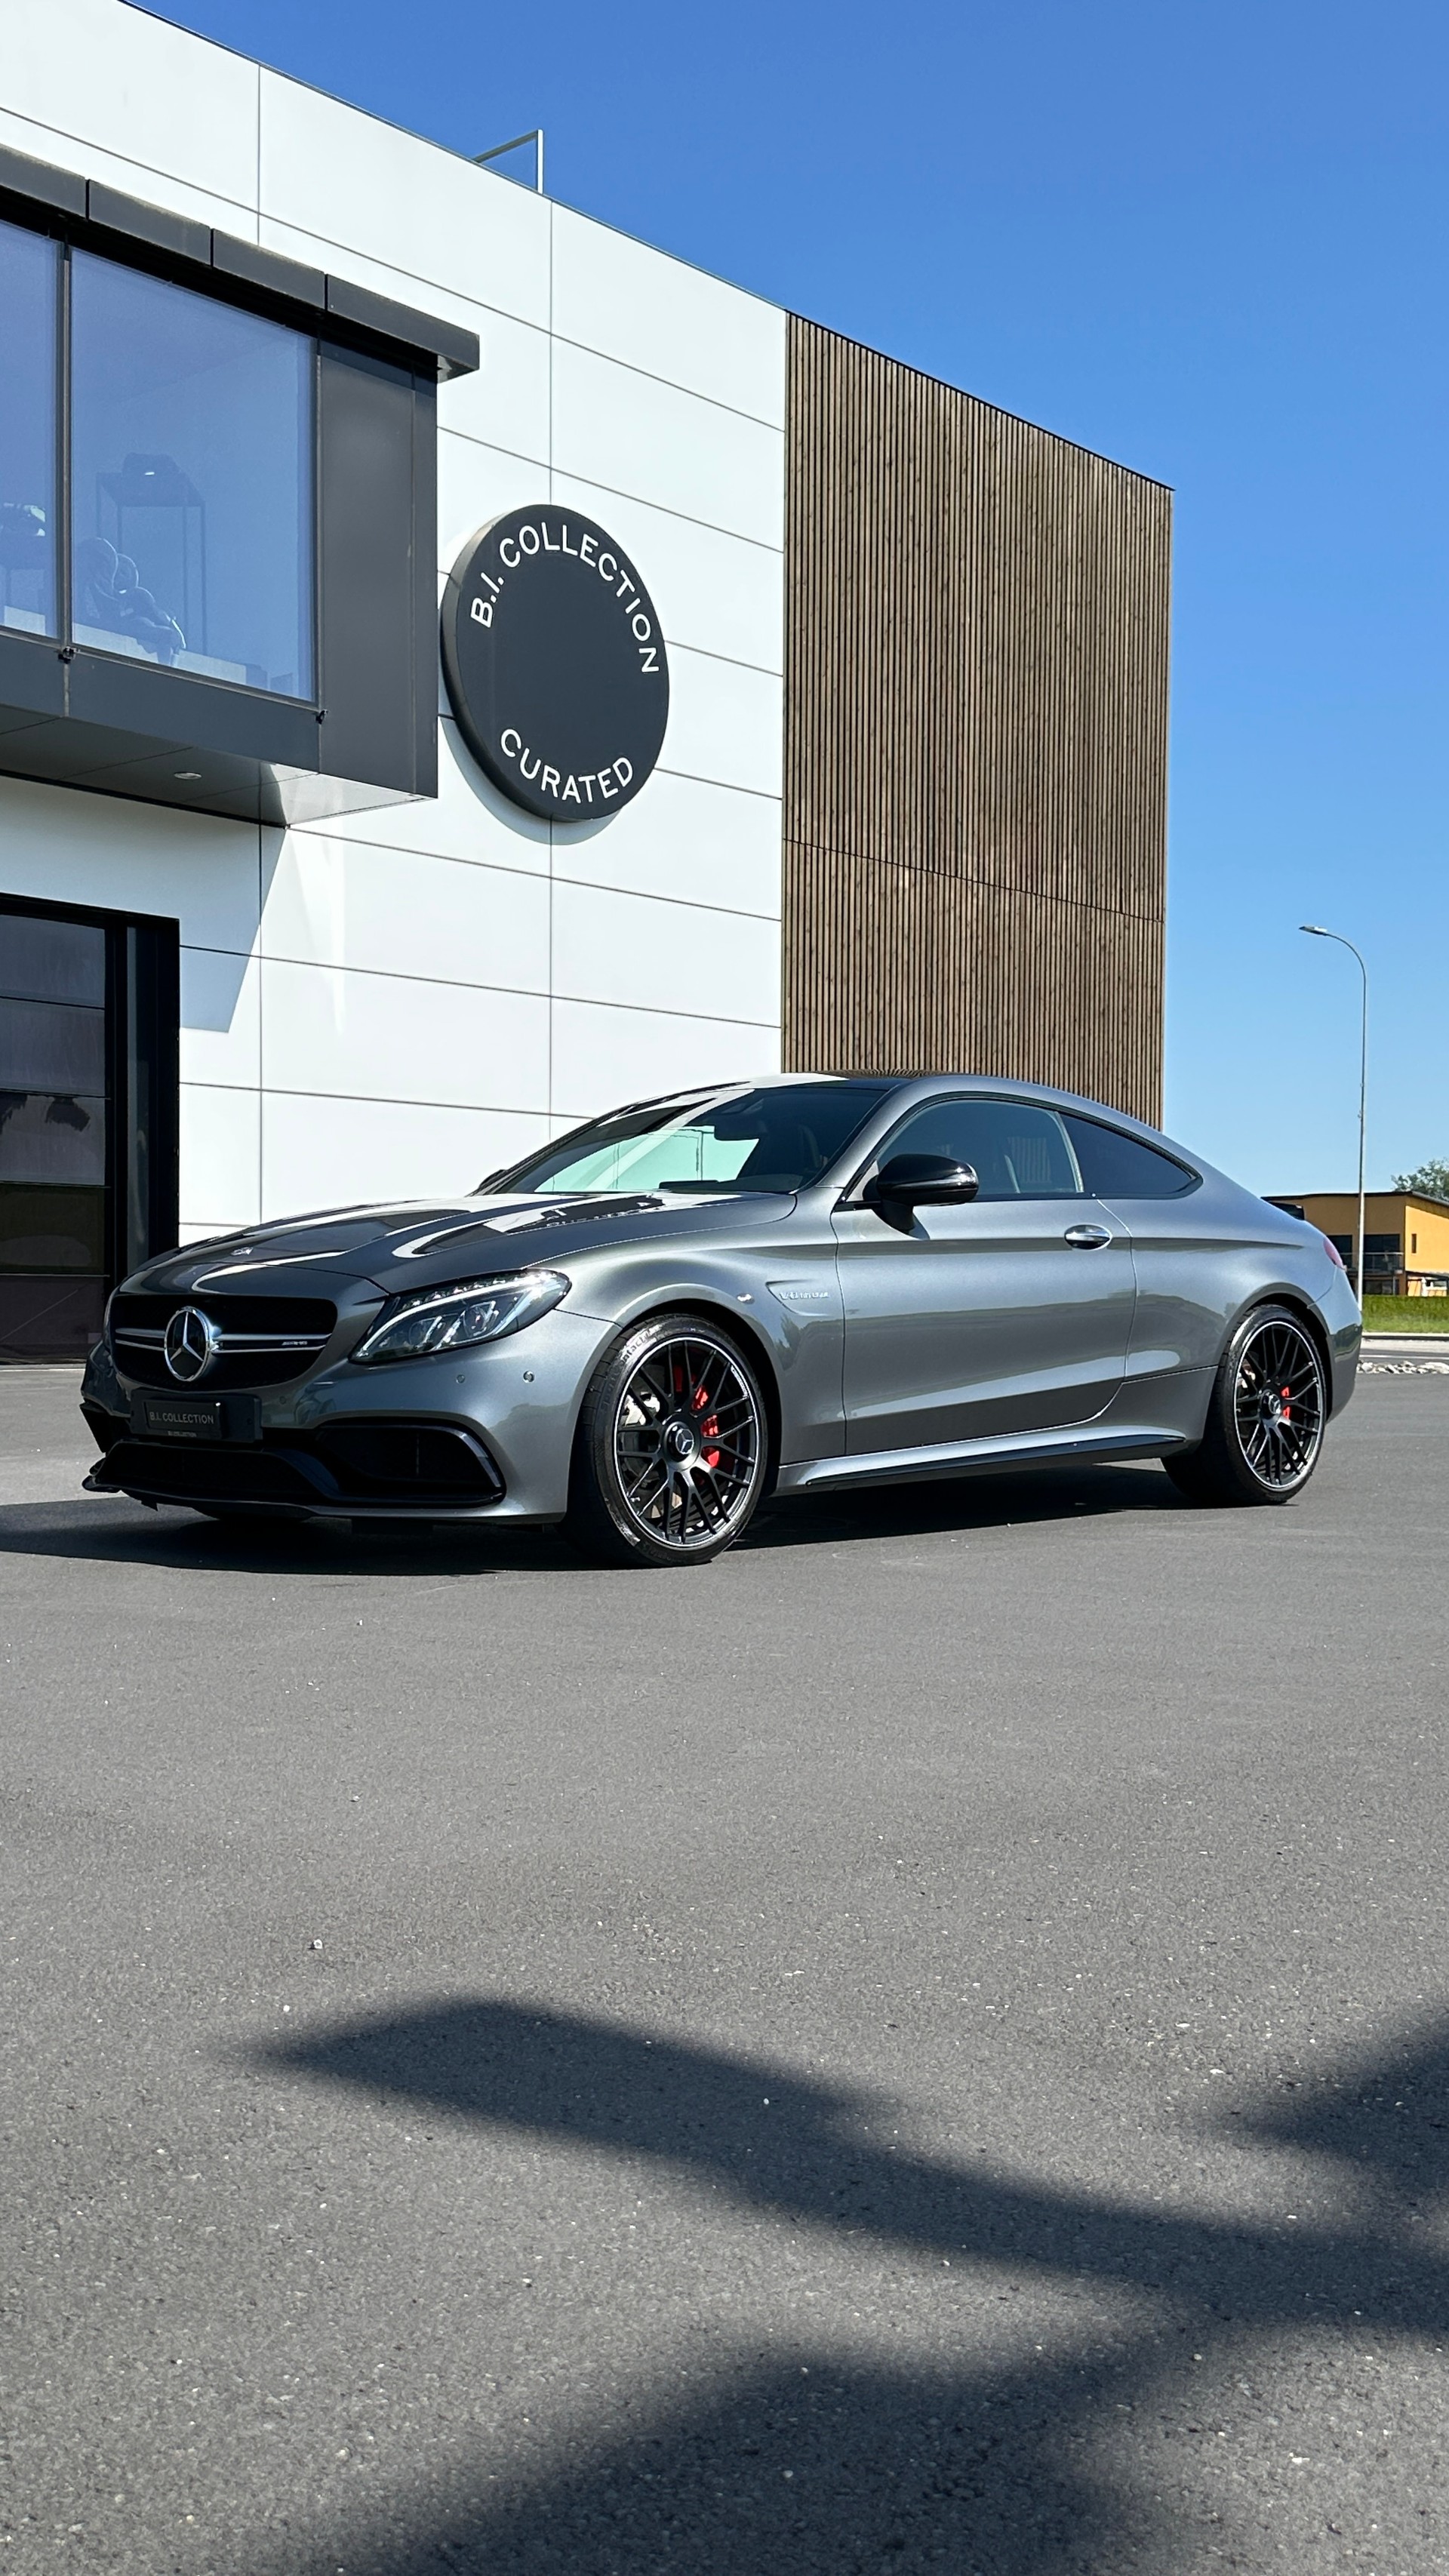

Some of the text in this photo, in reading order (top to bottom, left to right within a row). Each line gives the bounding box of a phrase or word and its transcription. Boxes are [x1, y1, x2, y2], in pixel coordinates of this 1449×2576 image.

[470, 522, 660, 673] B.I. COLLECTION
[500, 728, 634, 804] CURATED
[162, 1412, 214, 1424] COLLECTION
